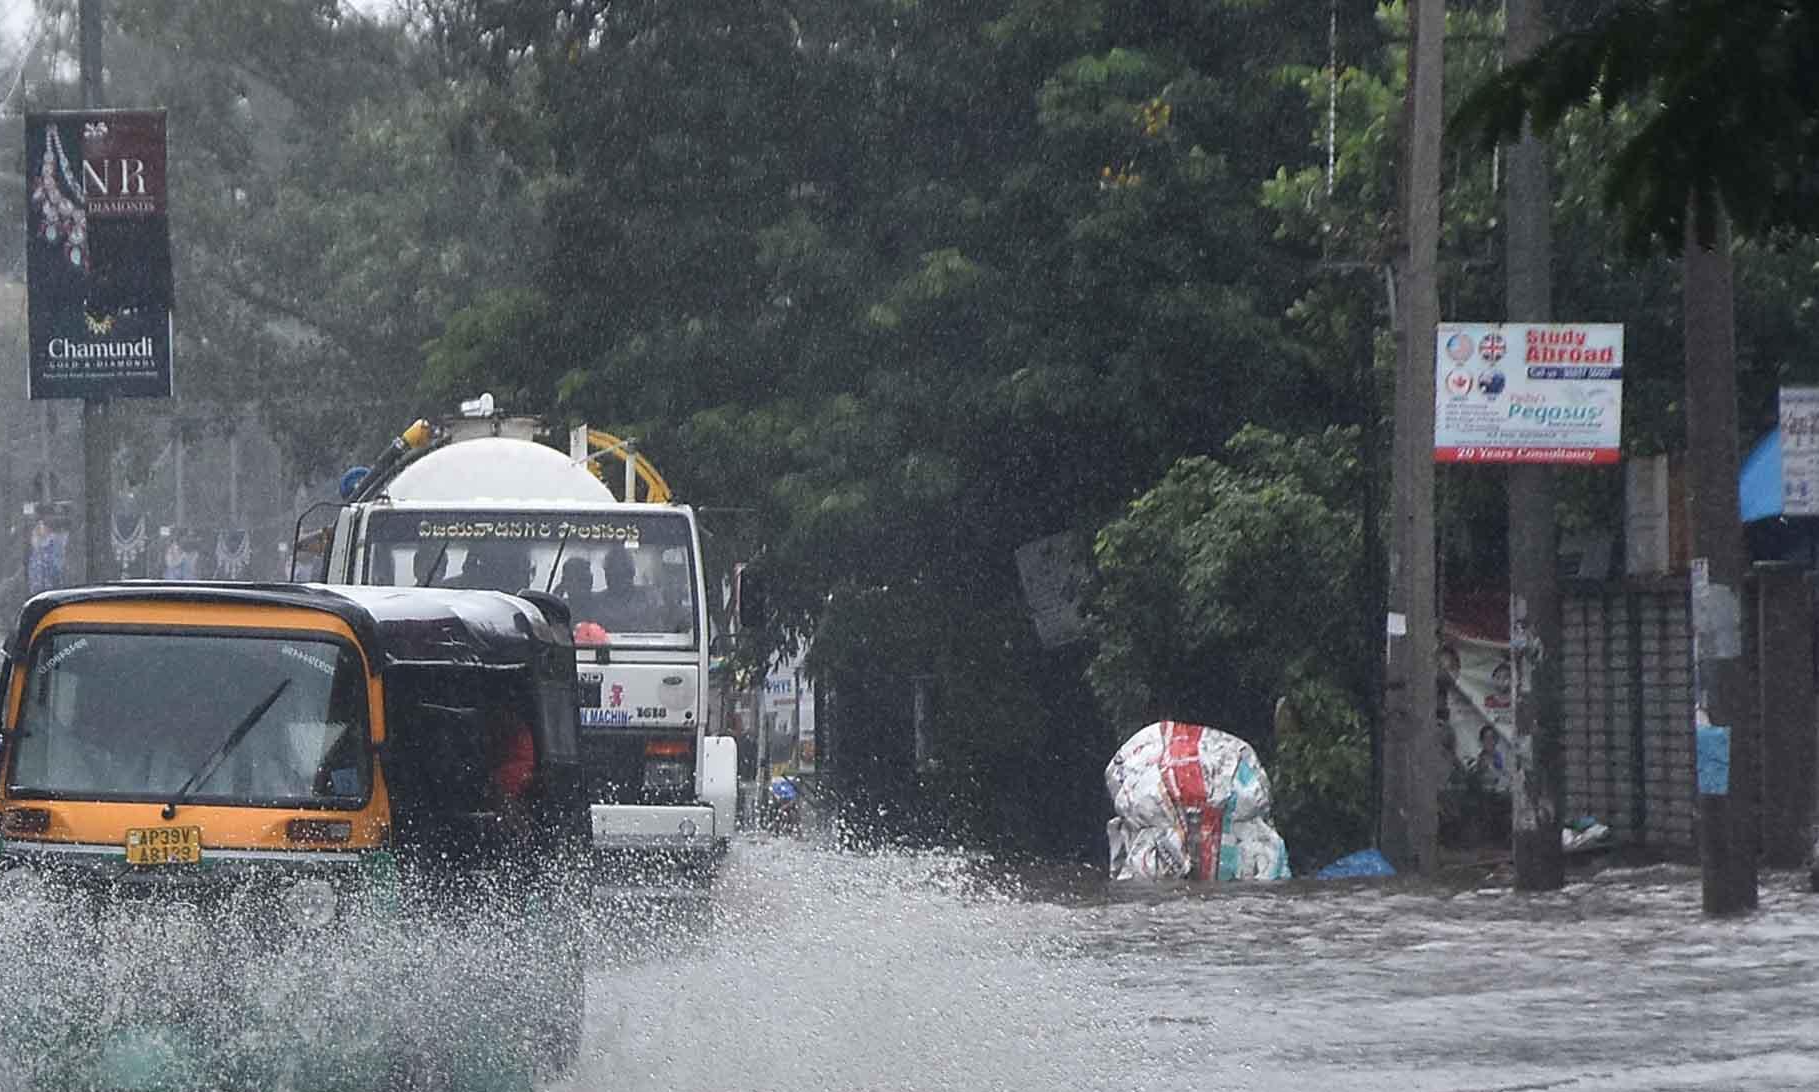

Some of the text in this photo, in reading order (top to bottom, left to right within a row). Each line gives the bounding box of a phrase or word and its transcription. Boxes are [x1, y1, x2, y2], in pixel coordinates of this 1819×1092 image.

[87, 201, 155, 213] DIAMONDS
[1525, 329, 1586, 346] Study
[48, 336, 153, 358] Chamundi
[1525, 346, 1613, 364] Abroad
[1508, 404, 1601, 425] Pegasus
[141, 827, 190, 845] AP39V
